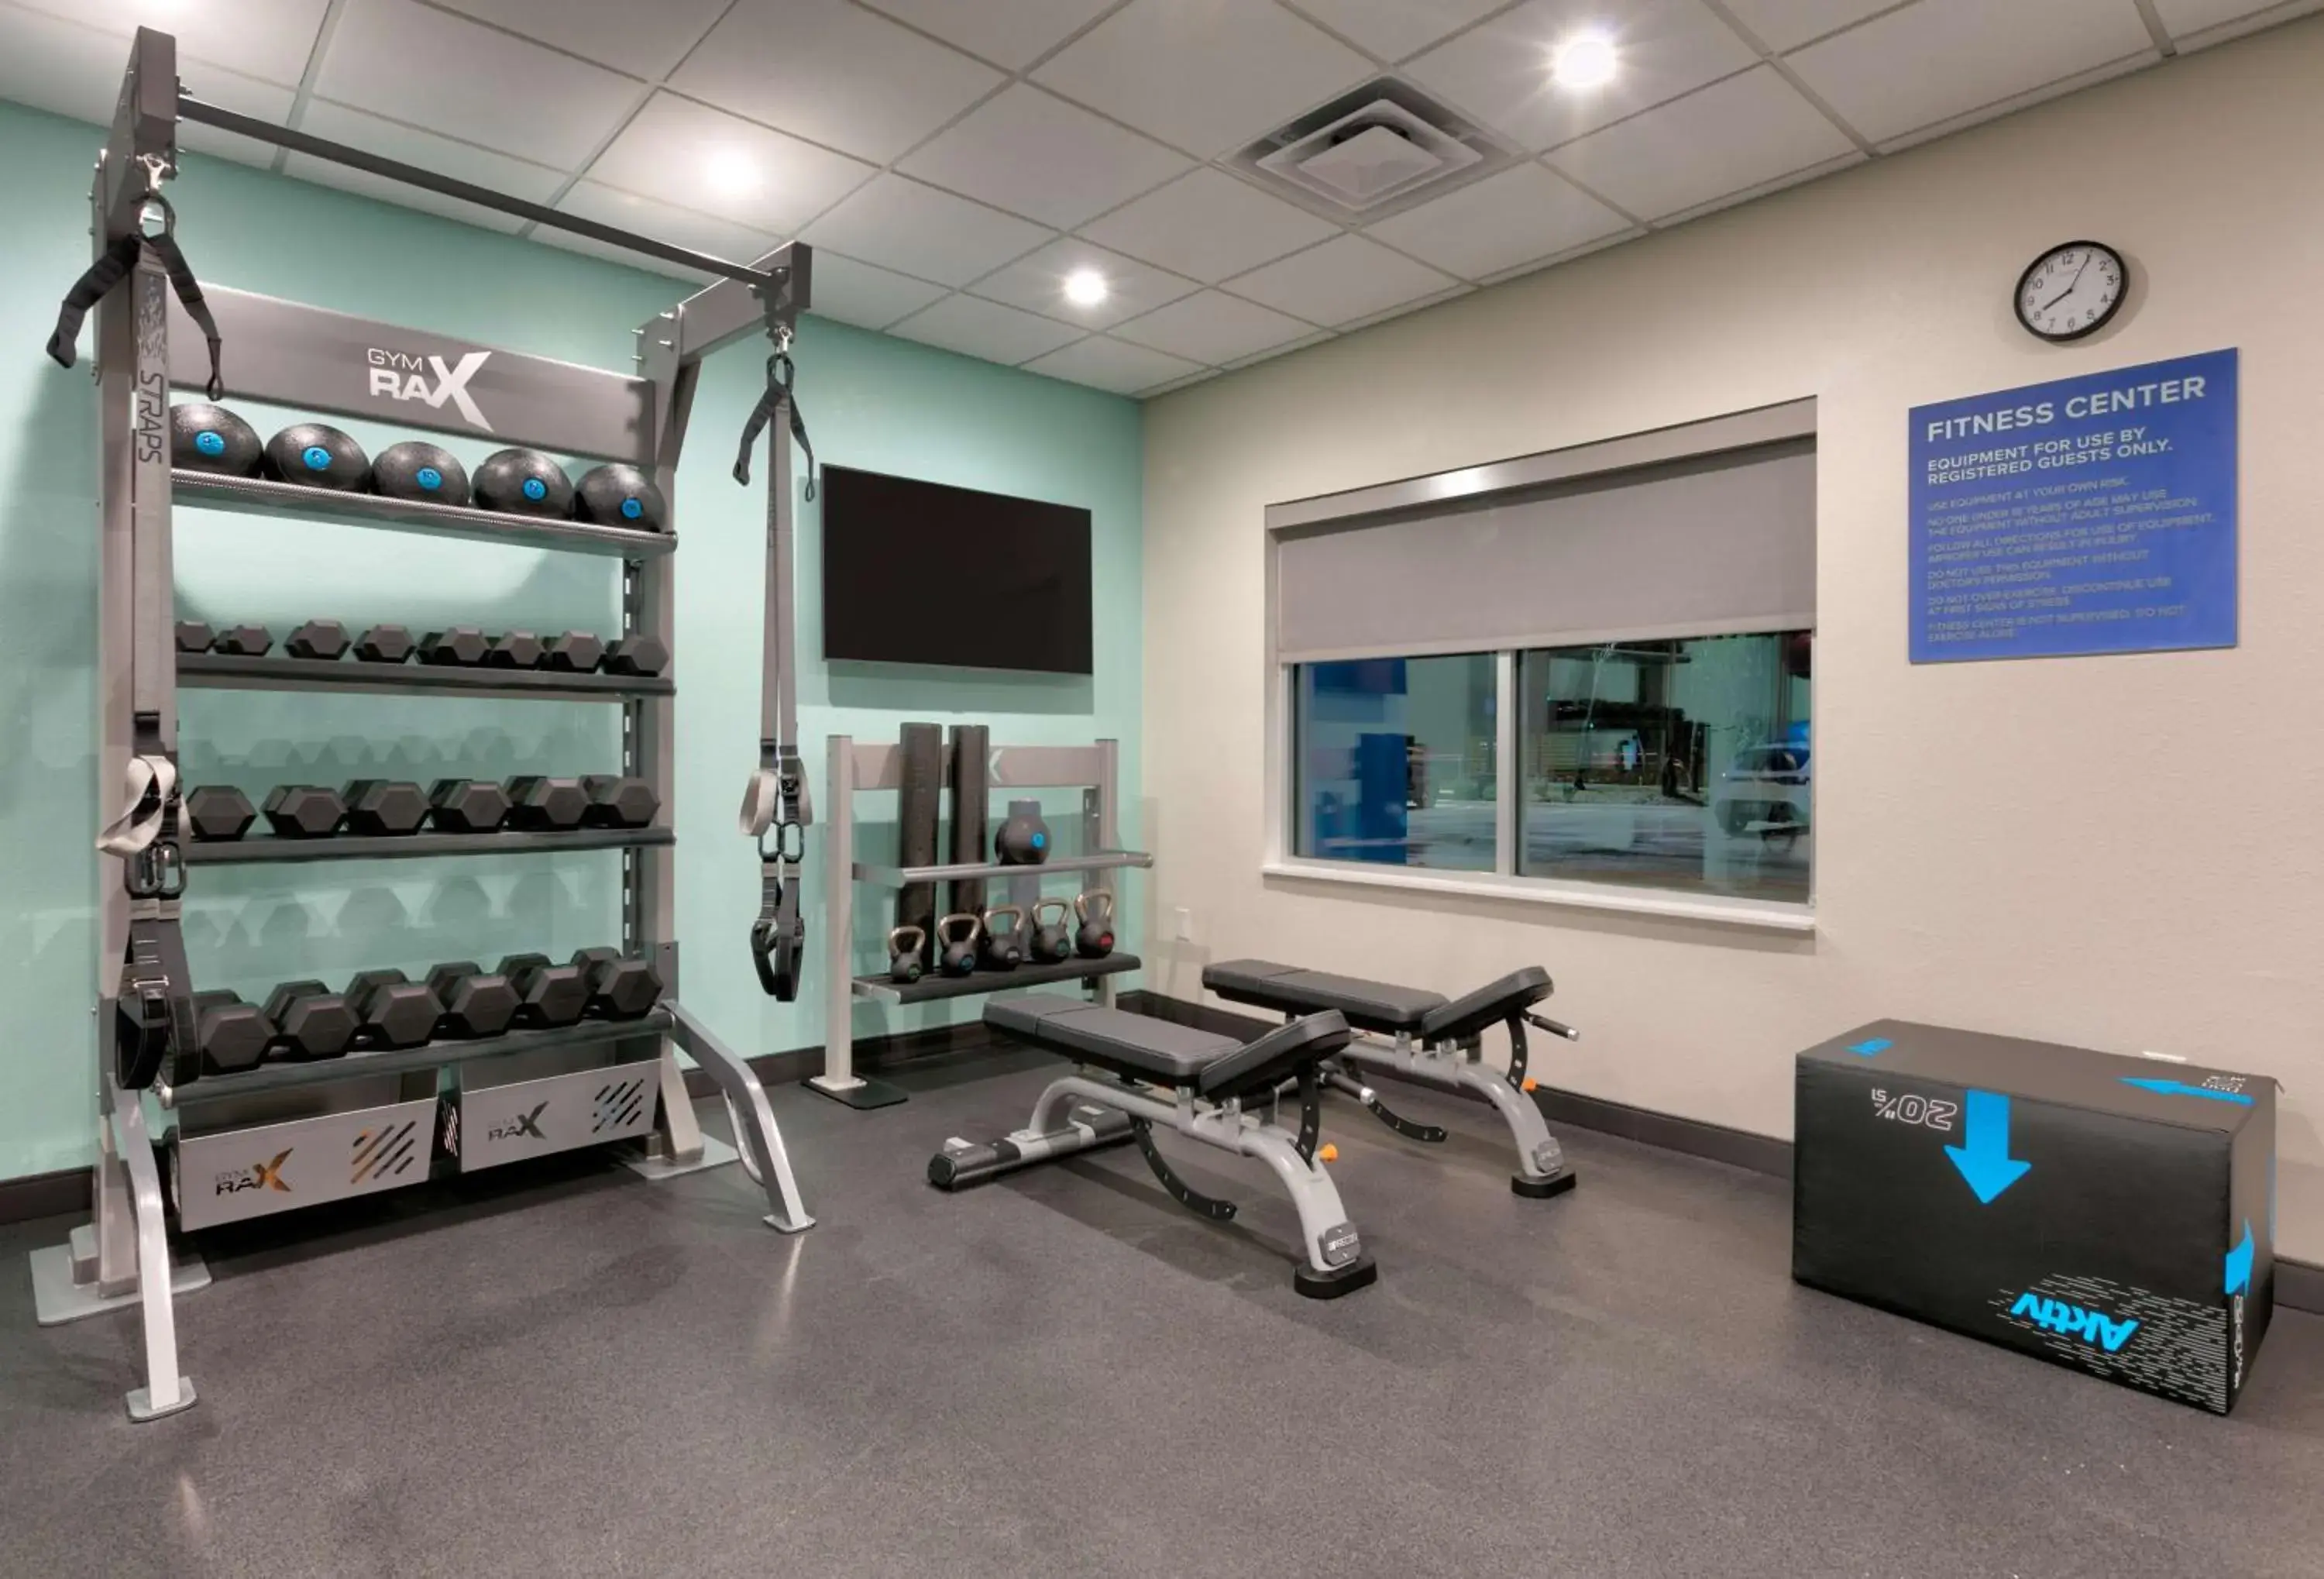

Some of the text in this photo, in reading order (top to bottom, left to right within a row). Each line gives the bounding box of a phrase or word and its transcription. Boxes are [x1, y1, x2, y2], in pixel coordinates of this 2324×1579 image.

[2061, 252, 2075, 265] 12
[2099, 260, 2109, 272] 2
[2106, 274, 2115, 286] 3
[2027, 295, 2035, 306] 9
[2099, 292, 2109, 304] 4
[2033, 311, 2041, 321] 8
[2085, 308, 2095, 319] 5
[2048, 318, 2056, 329] 7
[2067, 318, 2075, 329] 6
[366, 346, 422, 372] GYM
[1928, 376, 2205, 442] FITNESS CENTER
[1928, 427, 2146, 471] EQUIPMENT FOR USE BY
[1928, 438, 2173, 485] REGISTERED GUESTS ONLY.
[1950, 491, 2011, 507] EQUIPMENT
[2013, 489, 2027, 500] AT
[2033, 484, 2064, 497] YOUR
[2068, 480, 2097, 493] OWN
[1946, 514, 1971, 524] ONE
[1972, 508, 2009, 521] UNDER
[2064, 499, 2081, 509] OF
[2111, 492, 2138, 504] MAY
[2142, 488, 2167, 500] USE
[1950, 520, 2010, 534] EQUIPMENT
[2070, 508, 2109, 520] ADULT
[1927, 541, 1969, 552] FOLLOW
[2116, 521, 2136, 532] OF
[2006, 545, 2030, 555] CAN
[1927, 569, 1944, 579] DO
[1946, 567, 1968, 576] NOT
[2021, 556, 2088, 569] EQUIPMENT
[2092, 549, 2150, 563] WITHOUT
[2009, 1291, 2140, 1353] Aktiv
